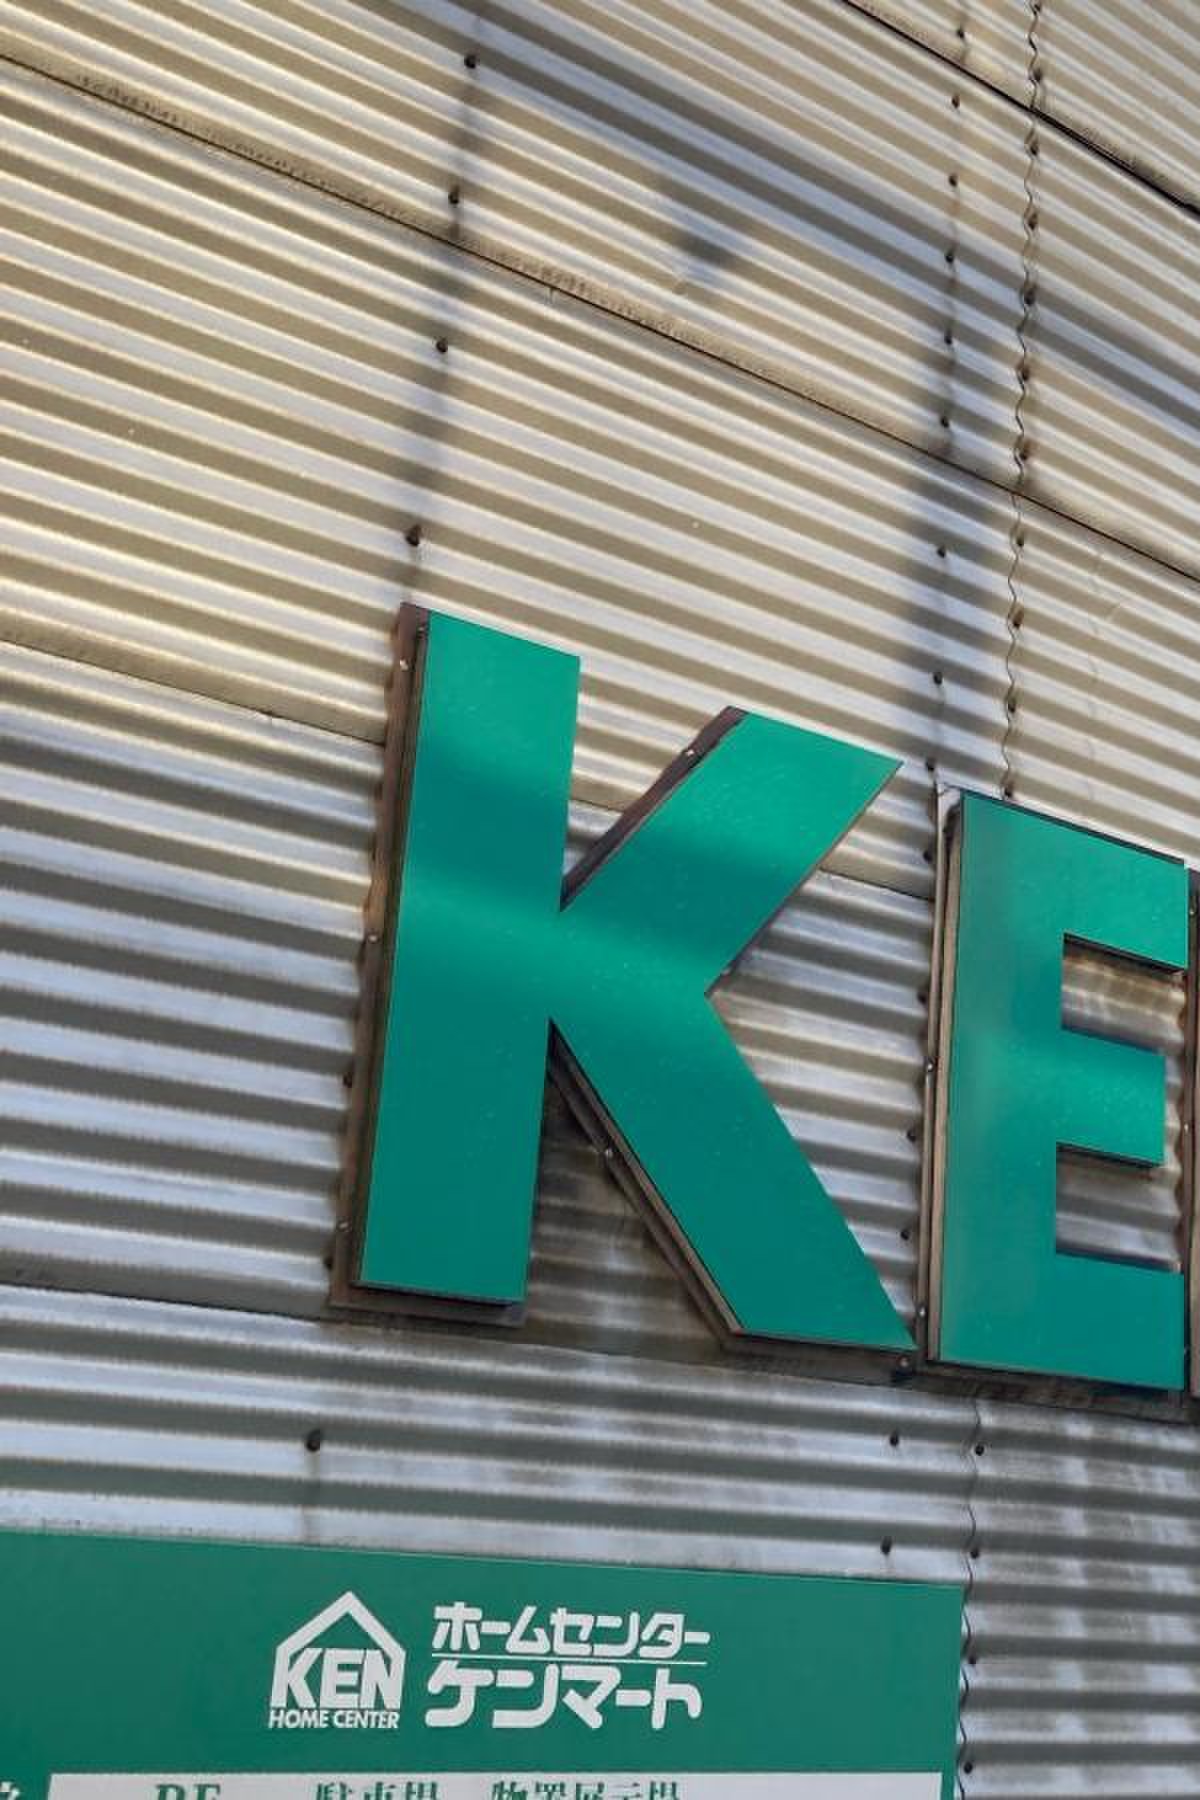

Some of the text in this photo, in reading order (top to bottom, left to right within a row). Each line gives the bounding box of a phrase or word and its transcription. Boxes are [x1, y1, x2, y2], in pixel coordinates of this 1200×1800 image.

[431, 1600, 710, 1660] ホームセンター
[270, 1646, 406, 1709] KEN
[424, 1659, 703, 1730] ケンマート
[268, 1709, 400, 1729] HOME CENTER
